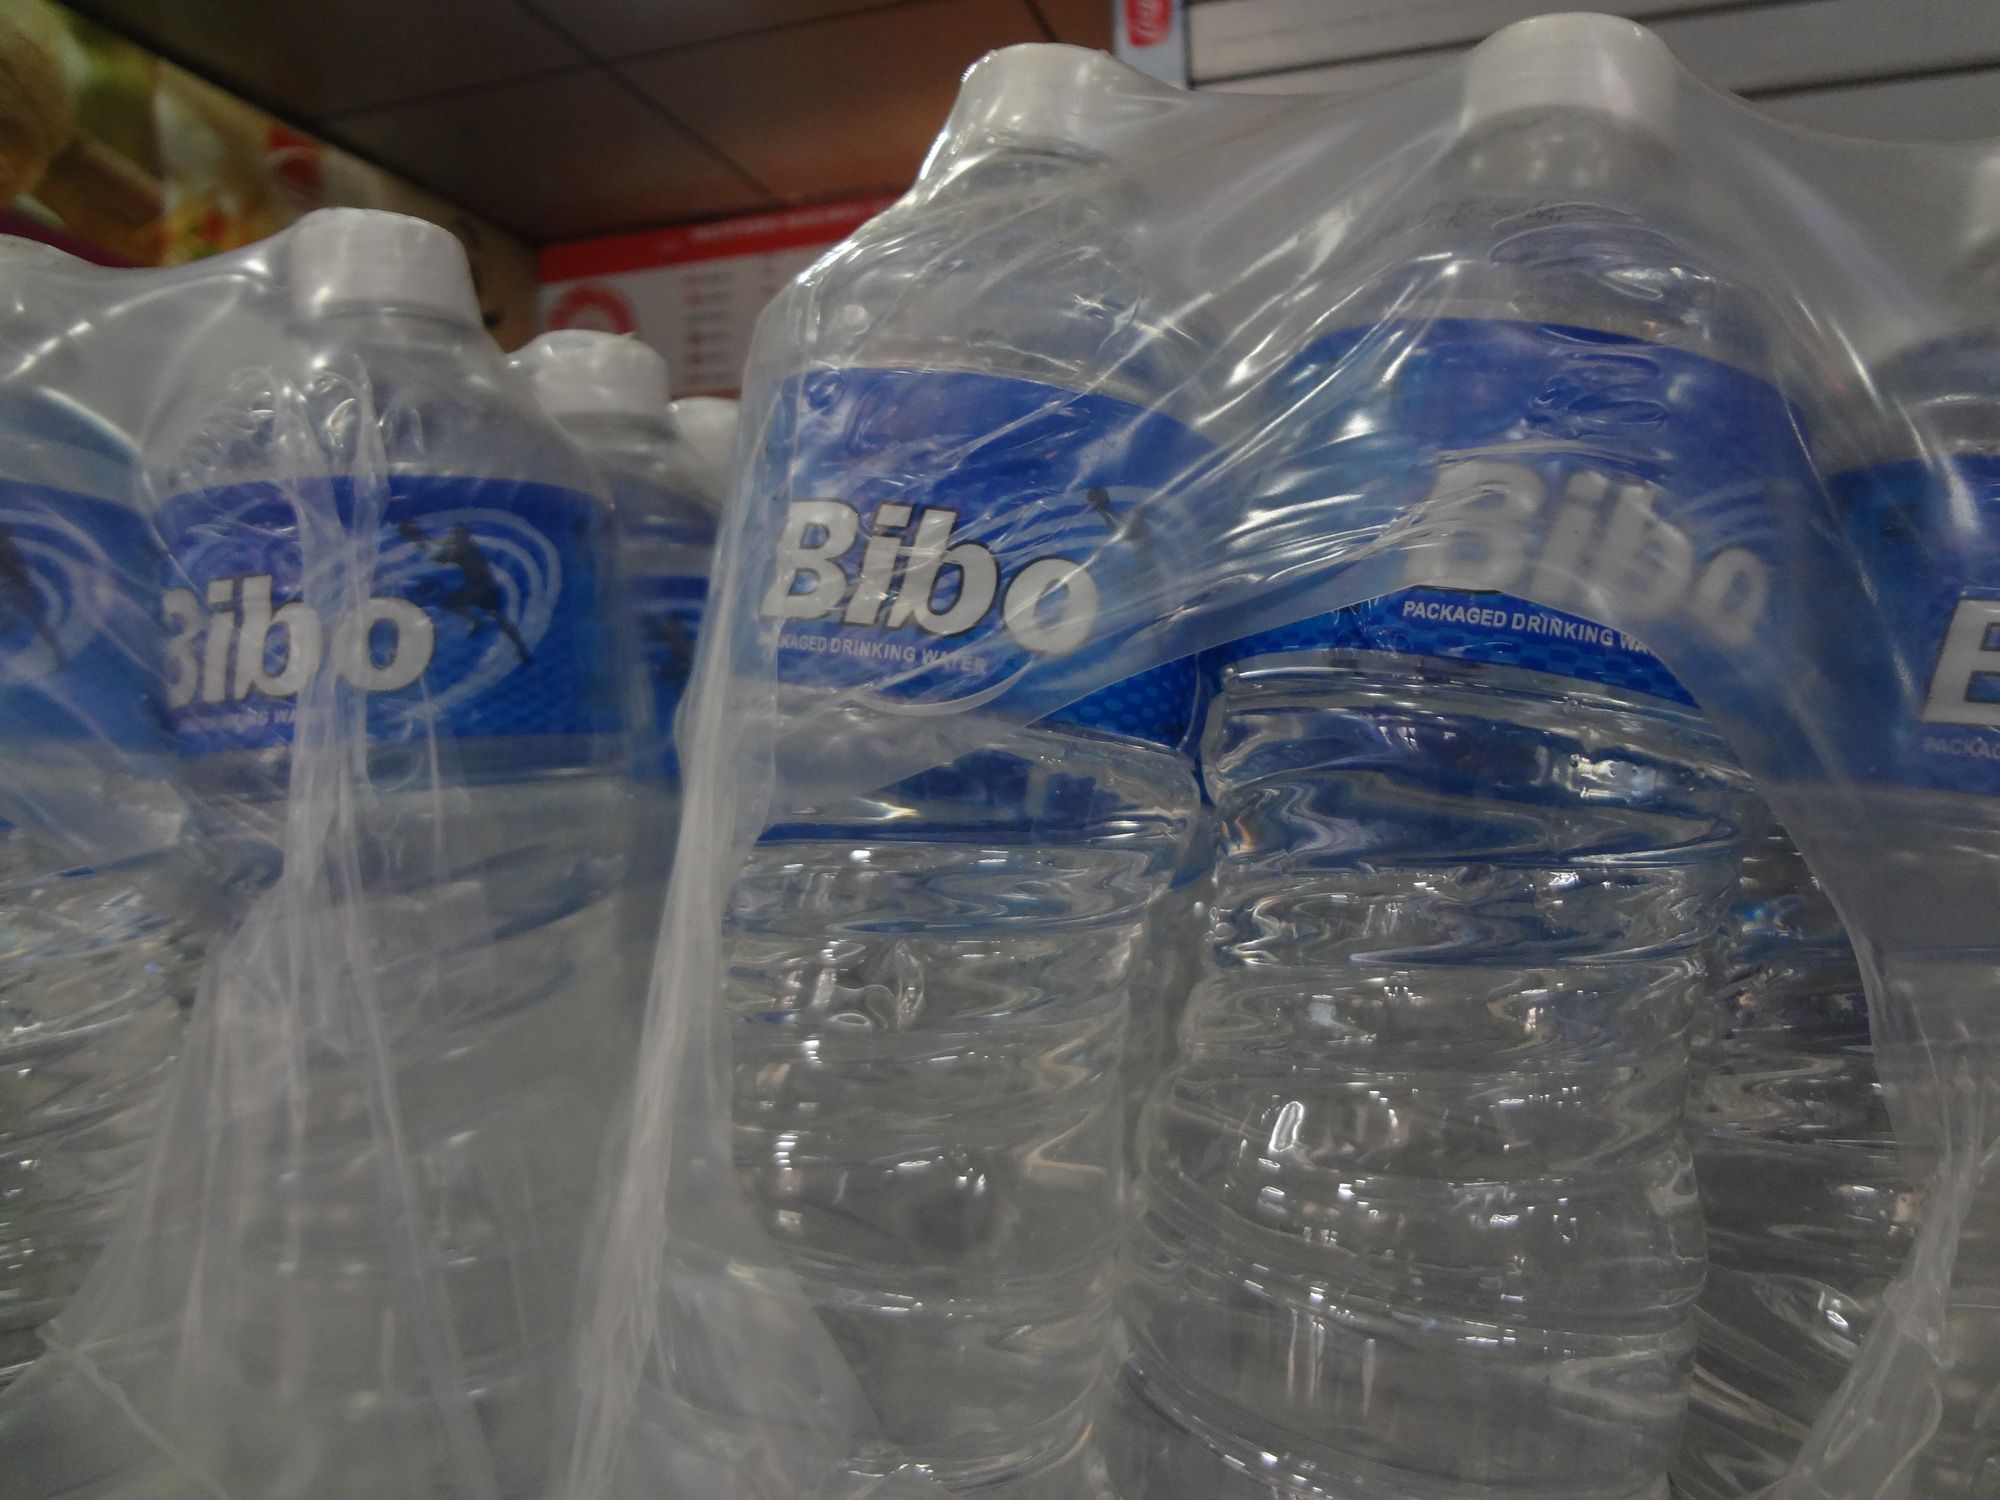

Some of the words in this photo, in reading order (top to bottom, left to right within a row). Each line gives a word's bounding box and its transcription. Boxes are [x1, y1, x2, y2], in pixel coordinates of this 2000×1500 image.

[759, 498, 1100, 658] Bibo
[1402, 458, 1768, 645] Bibo
[830, 636, 916, 662] DRINKING
[1402, 600, 1508, 628] PACKAGED
[1511, 612, 1615, 647] DRINKING
